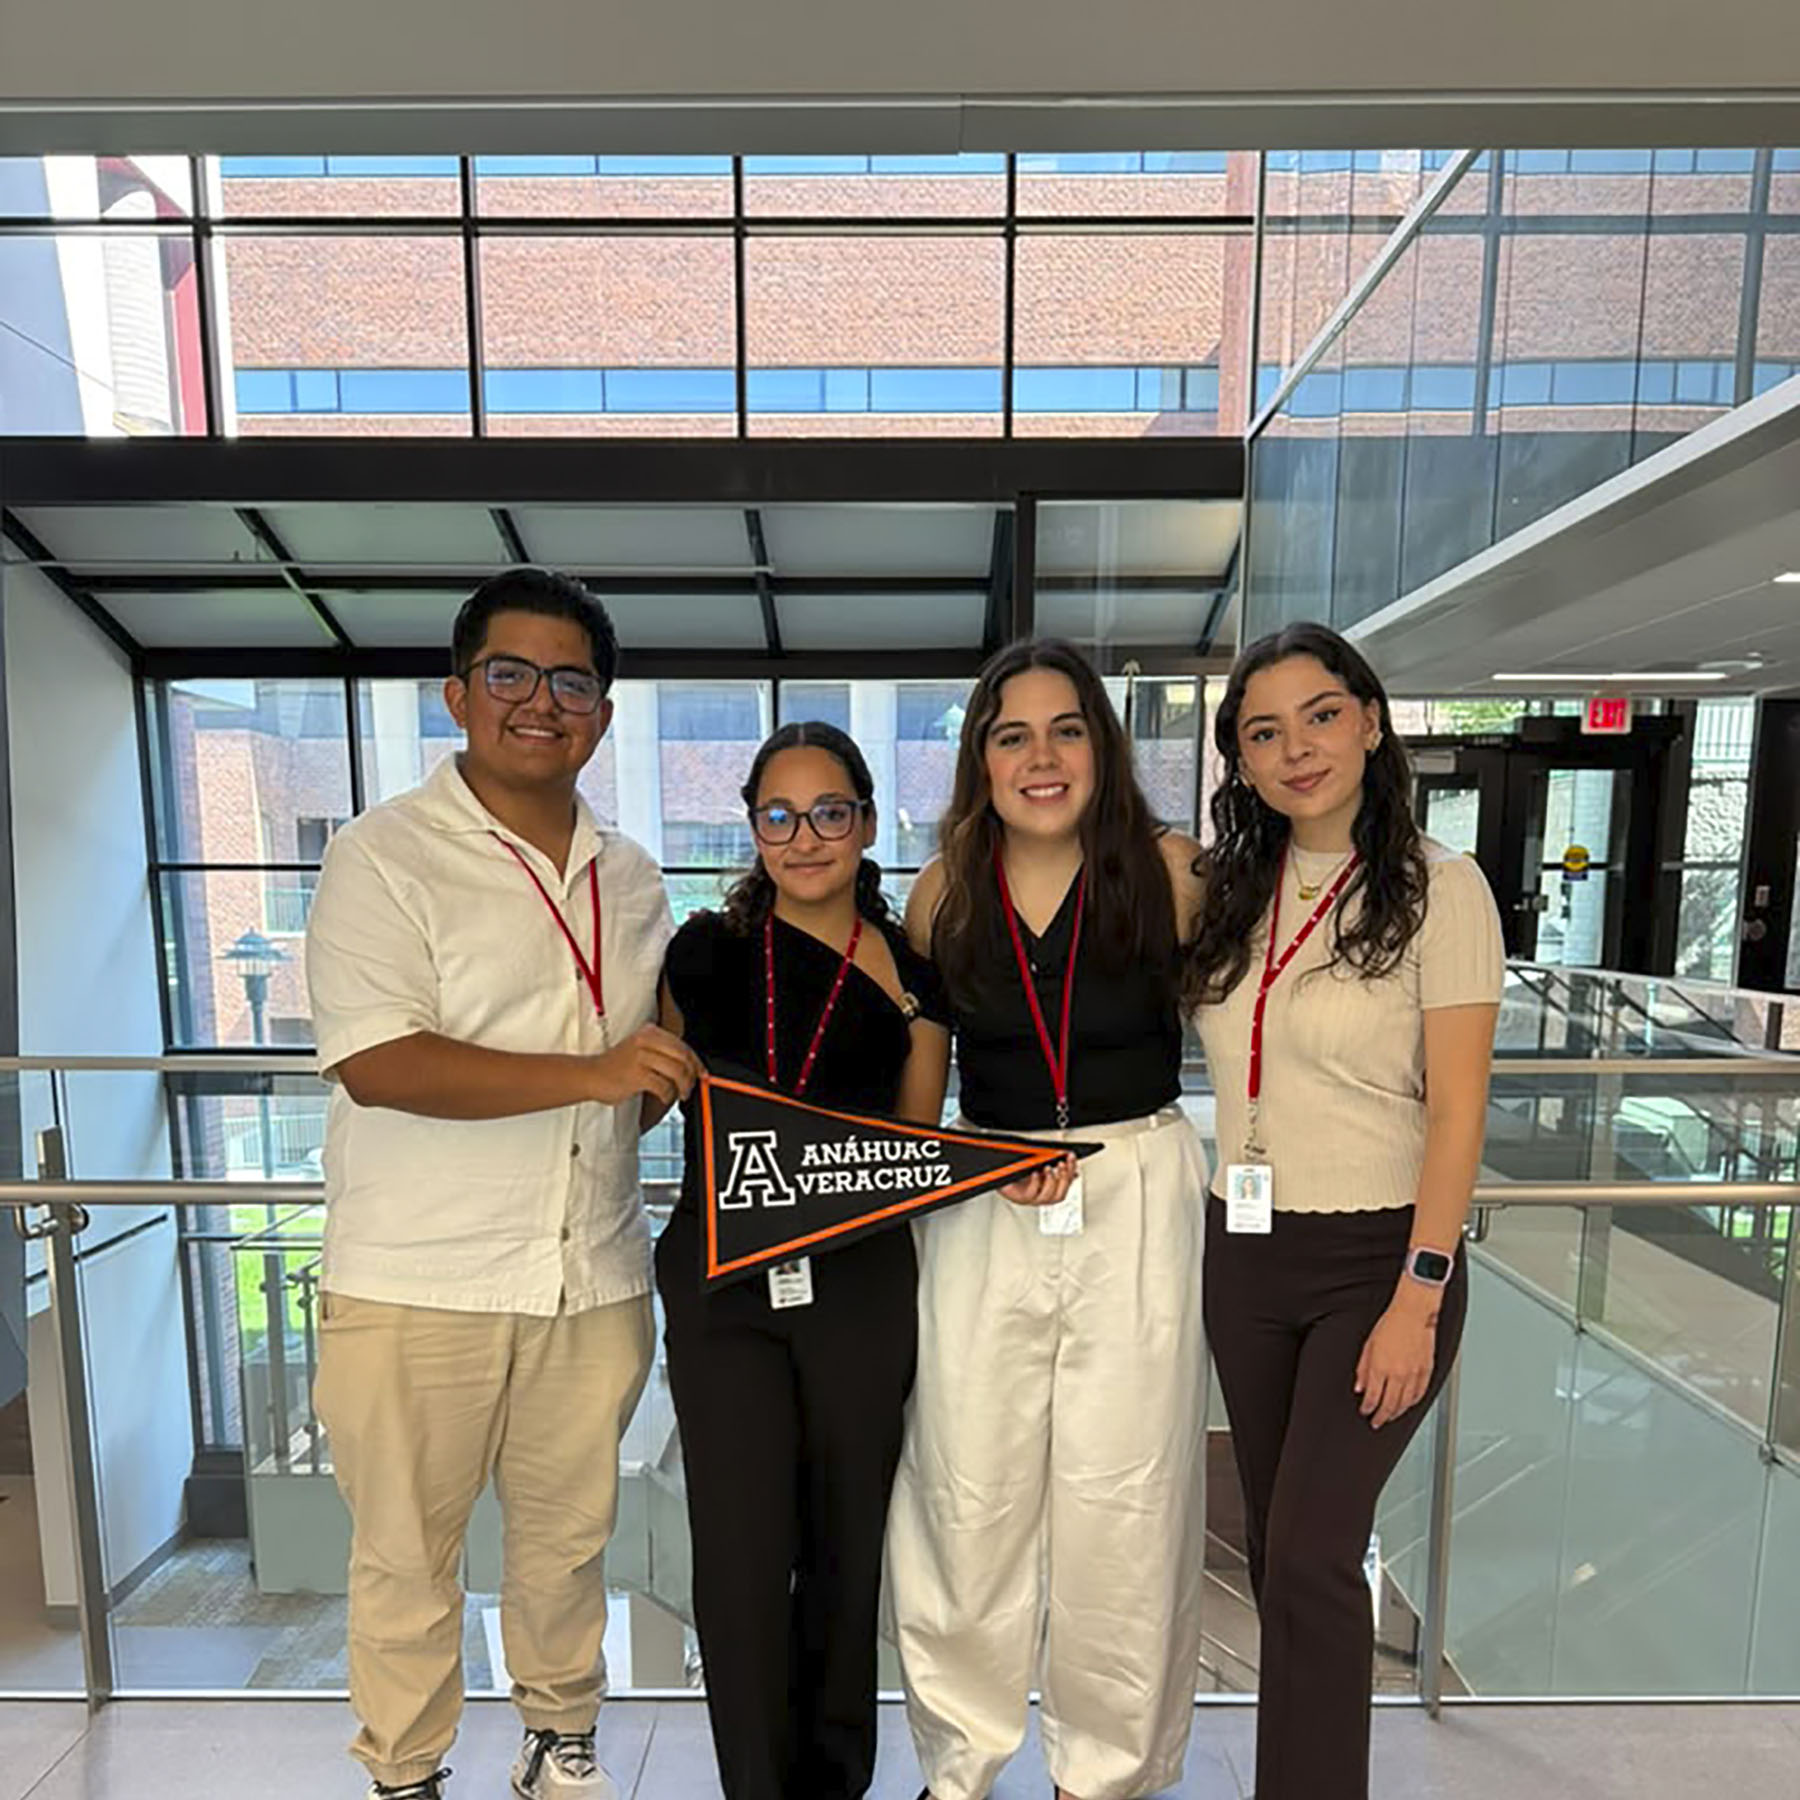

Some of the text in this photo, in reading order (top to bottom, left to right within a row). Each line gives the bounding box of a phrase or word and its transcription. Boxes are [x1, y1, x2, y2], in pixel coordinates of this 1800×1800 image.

[1589, 698, 1626, 729] EXIT
[801, 1135, 941, 1166] ANÁHUAC
[718, 1130, 796, 1209] A
[795, 1164, 951, 1195] VERACRUZ
